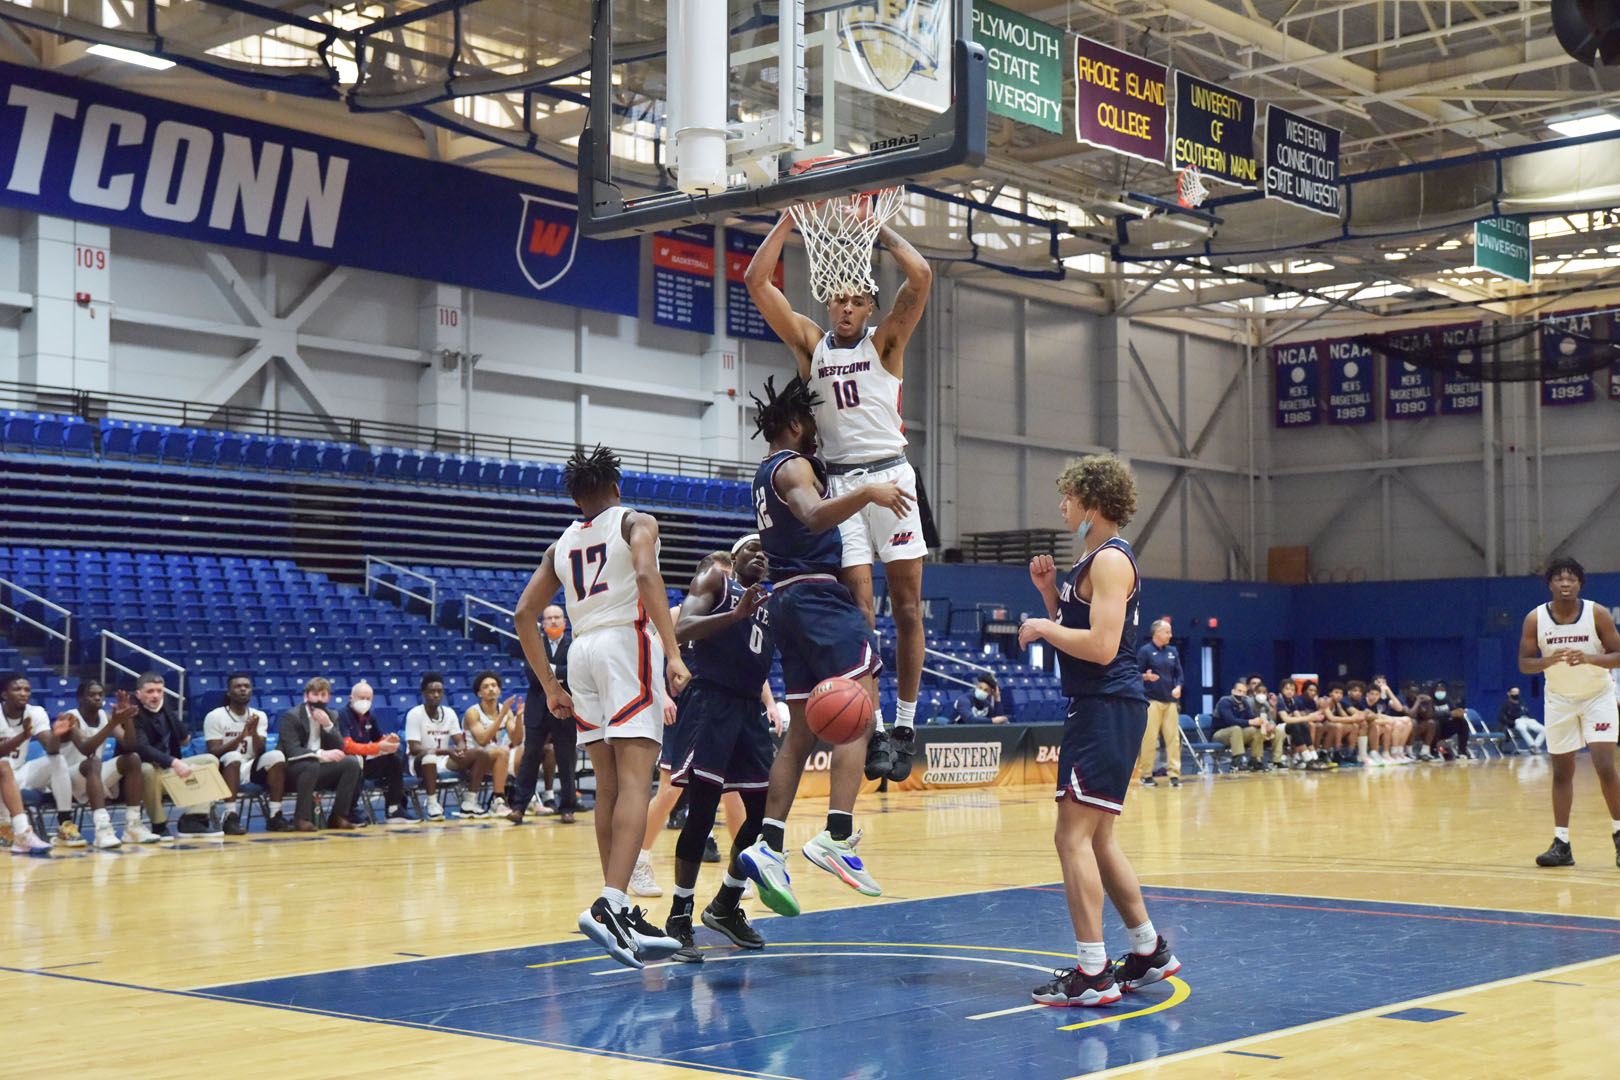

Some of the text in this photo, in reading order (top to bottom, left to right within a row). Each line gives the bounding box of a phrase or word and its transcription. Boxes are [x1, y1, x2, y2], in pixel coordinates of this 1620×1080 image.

[972, 9, 1060, 60] PLYMOUTH
[988, 48, 1040, 85] STATE
[1079, 56, 1166, 106] RHODE ISLAND
[986, 79, 1061, 122] IVERSITY
[1191, 84, 1242, 122] UNIVERSITY
[1097, 102, 1152, 140] COLLEGE
[1210, 119, 1224, 143] OF
[1285, 118, 1326, 152] WESTERN
[7, 84, 349, 249] TCONN
[1176, 137, 1226, 173] SOUTHERN
[1277, 144, 1335, 181] CONNECTICUT
[1268, 166, 1341, 209] STATE UNIVERSITY
[528, 219, 570, 257] W
[1480, 216, 1529, 238] ASTLETON
[76, 247, 105, 270] 109
[1477, 232, 1529, 260] UNIVERSITY
[440, 308, 458, 327] 110
[722, 353, 735, 369] 111
[1278, 346, 1318, 365] NCAA
[1329, 343, 1372, 360] NCAA
[818, 361, 870, 379] WESTCONN
[832, 380, 860, 410] 10
[1444, 382, 1482, 394] BASKETBAL
[1551, 385, 1584, 399] 1992
[1336, 406, 1366, 419] 1989
[1395, 401, 1426, 413] 1990
[1452, 396, 1478, 408] 1991
[568, 542, 609, 602] 12
[749, 624, 763, 654] 0
[1546, 635, 1589, 645] WESTCONN
[928, 746, 999, 769] WESTERN
[924, 770, 998, 783] CONNECTICUT
